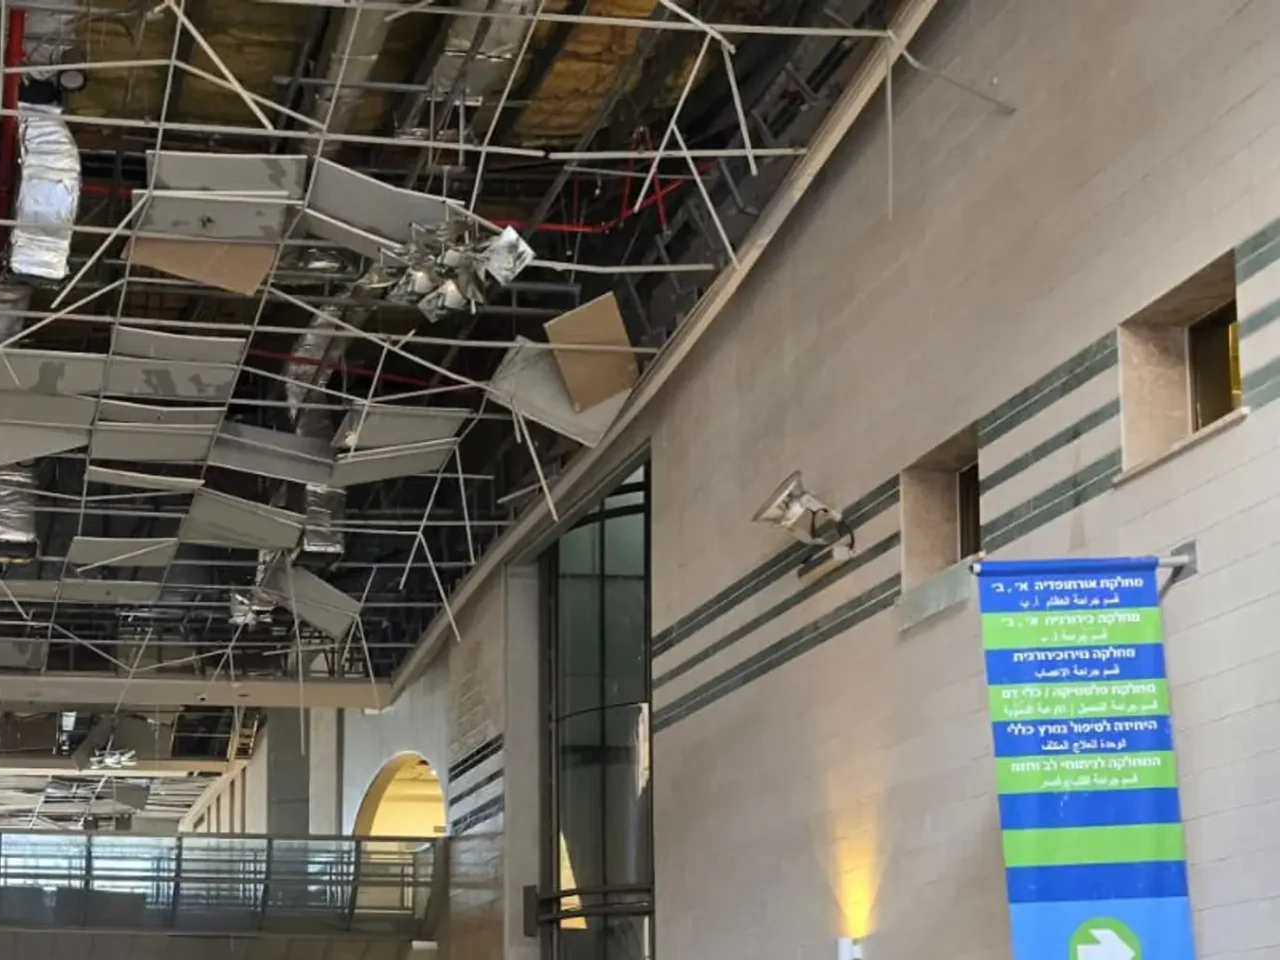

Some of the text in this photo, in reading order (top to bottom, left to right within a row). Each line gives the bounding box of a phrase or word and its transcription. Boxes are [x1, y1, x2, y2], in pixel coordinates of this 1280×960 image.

[1034, 578, 1096, 590] אורתופדיה
[1001, 688, 1018, 699] דם
[1022, 686, 1041, 698] כלי
[1051, 684, 1108, 699] פלסטיקה
[1007, 720, 1157, 737] היחידה לטיפול נמרץ כללי
[1042, 759, 1057, 771] לב
[1060, 757, 1105, 770] לניתוחי
